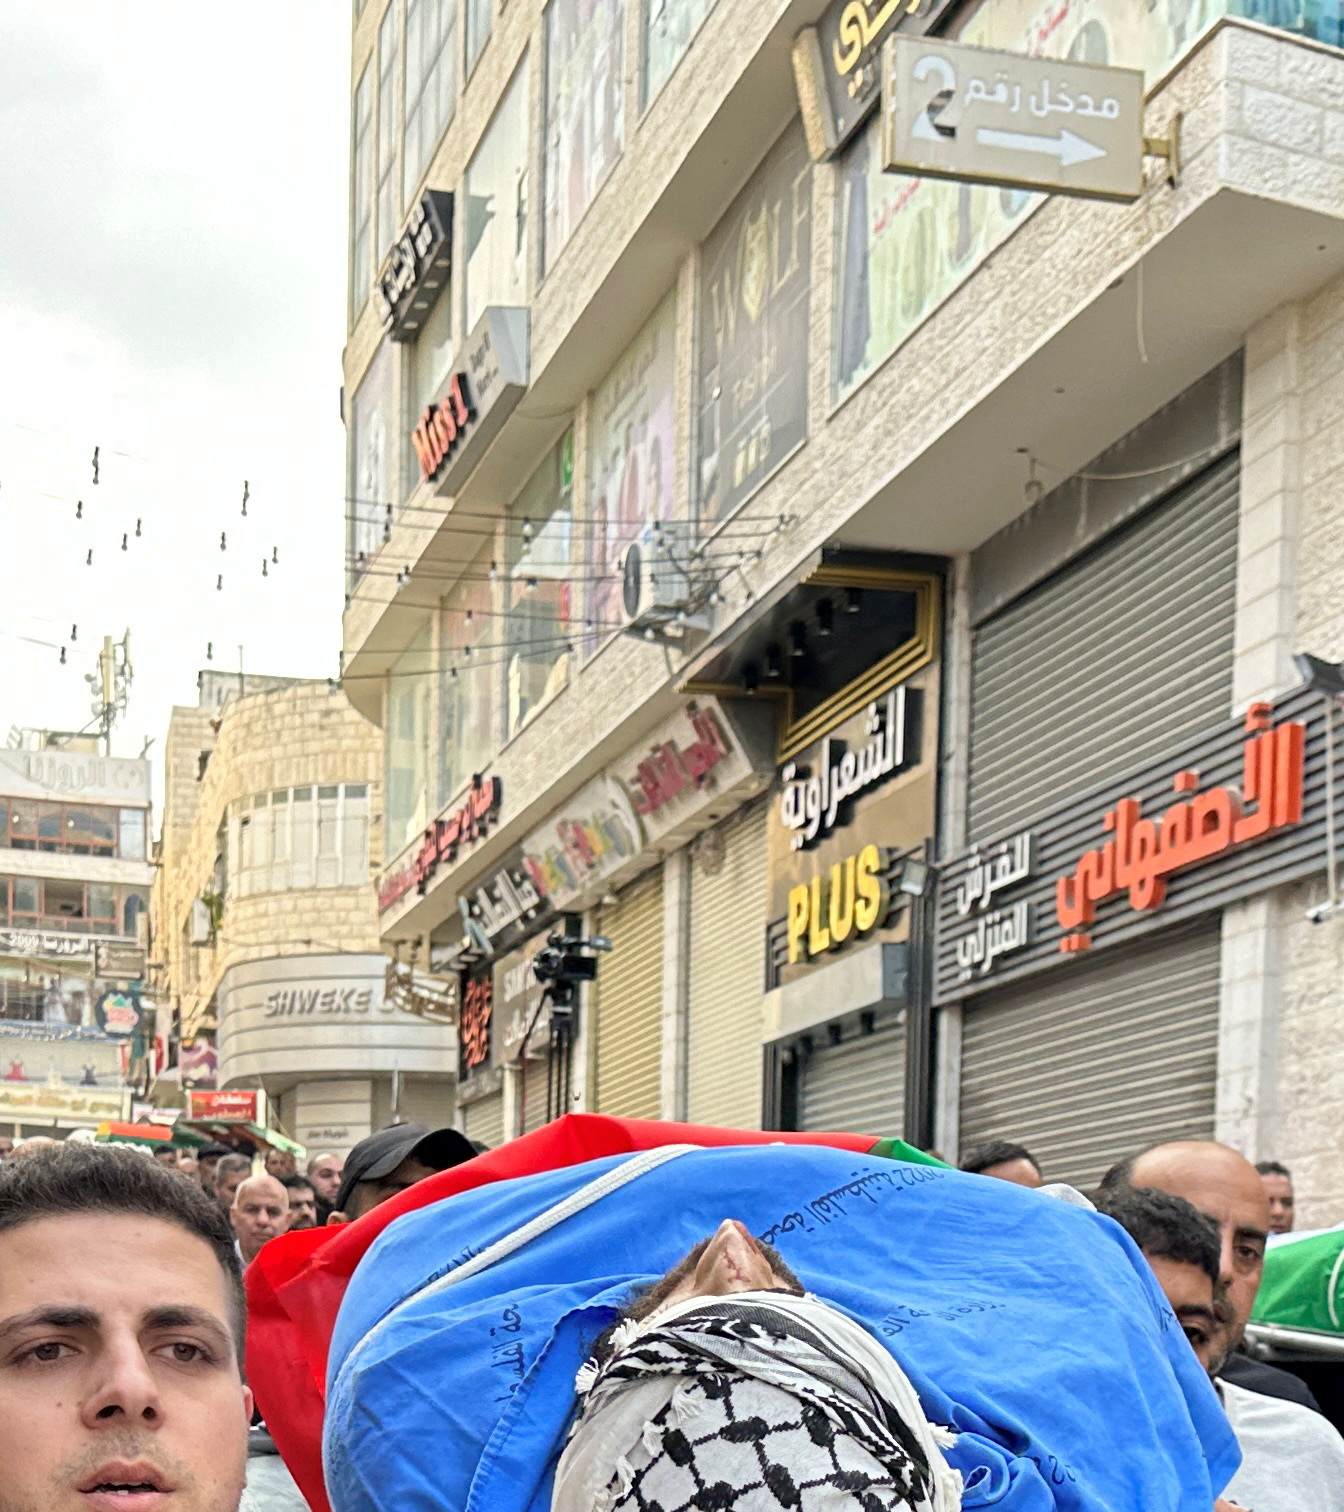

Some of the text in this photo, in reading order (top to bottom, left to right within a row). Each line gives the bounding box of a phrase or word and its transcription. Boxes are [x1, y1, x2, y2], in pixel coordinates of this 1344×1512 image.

[911, 53, 1121, 143] مدخل رقم 2
[780, 684, 907, 851] الشعراوية
[1056, 702, 1306, 958] الأصفهاني
[788, 843, 881, 965] PLUS
[264, 987, 373, 1018] SHWEKE
[803, 1167, 905, 1224] الفلسطينية
